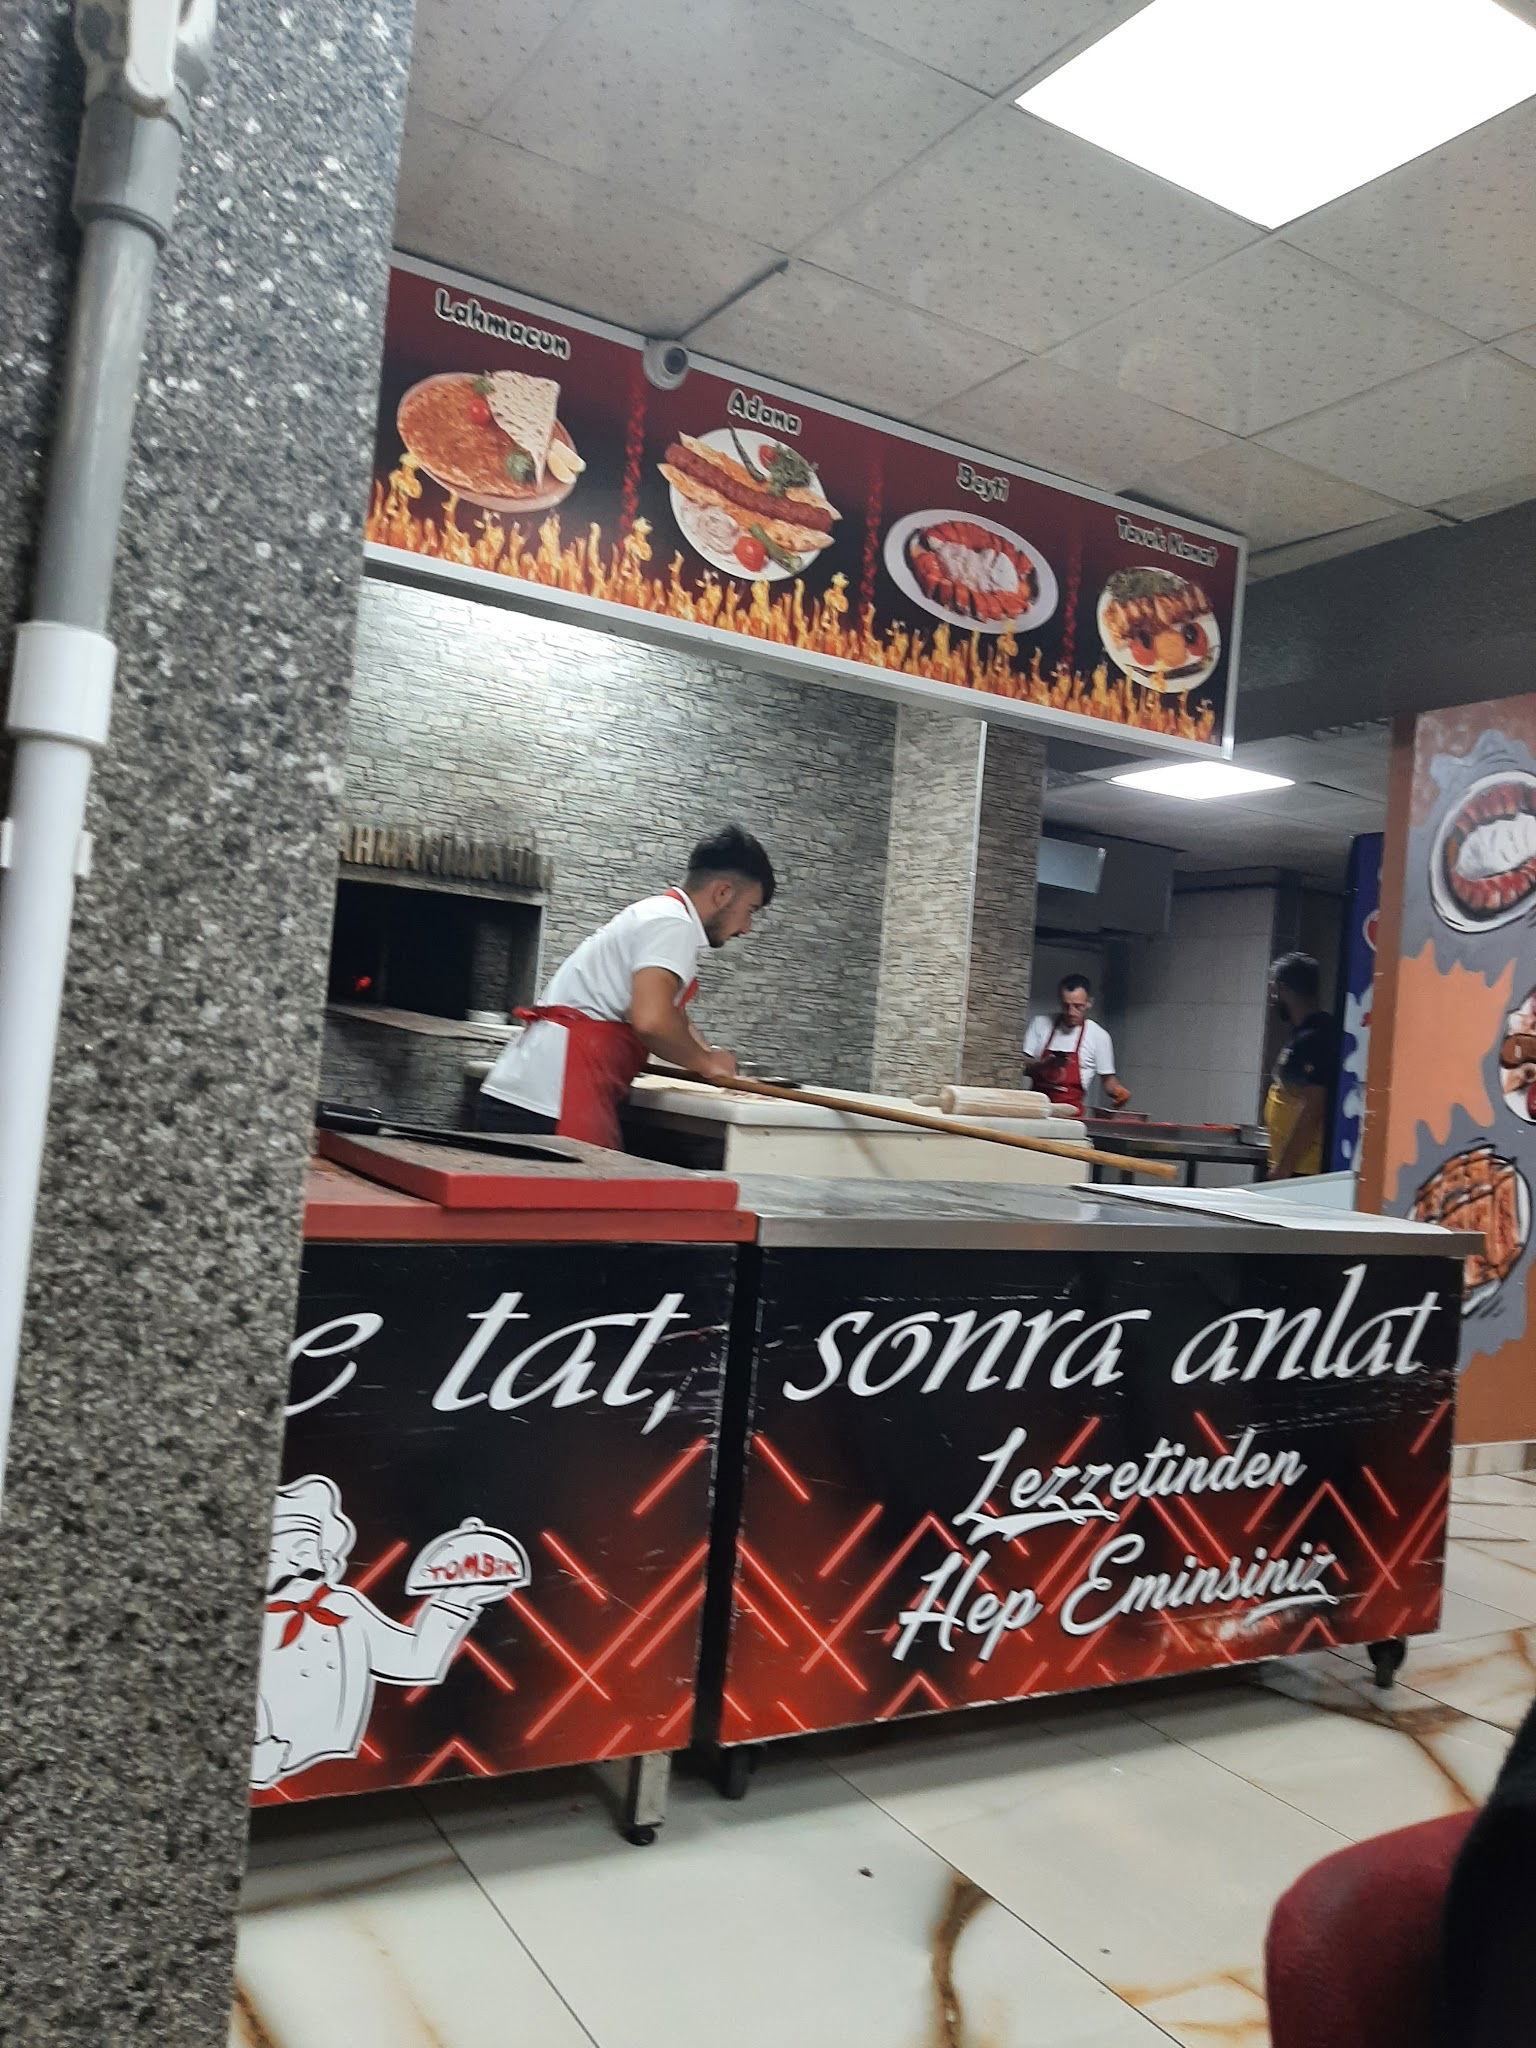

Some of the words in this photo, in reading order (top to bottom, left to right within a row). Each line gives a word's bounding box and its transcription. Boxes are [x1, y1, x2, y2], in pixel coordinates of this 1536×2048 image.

[435, 287, 571, 361] Lahmacun
[727, 388, 802, 437] Adana
[956, 462, 1010, 503] Beyti
[431, 1291, 692, 1435] tat,
[782, 1308, 1152, 1401] sonra
[1171, 1263, 1443, 1385] anlat
[951, 1426, 1307, 1545] Lezzetinden
[892, 1549, 1043, 1661] Hep
[1059, 1533, 1338, 1635] Eminsiniz
